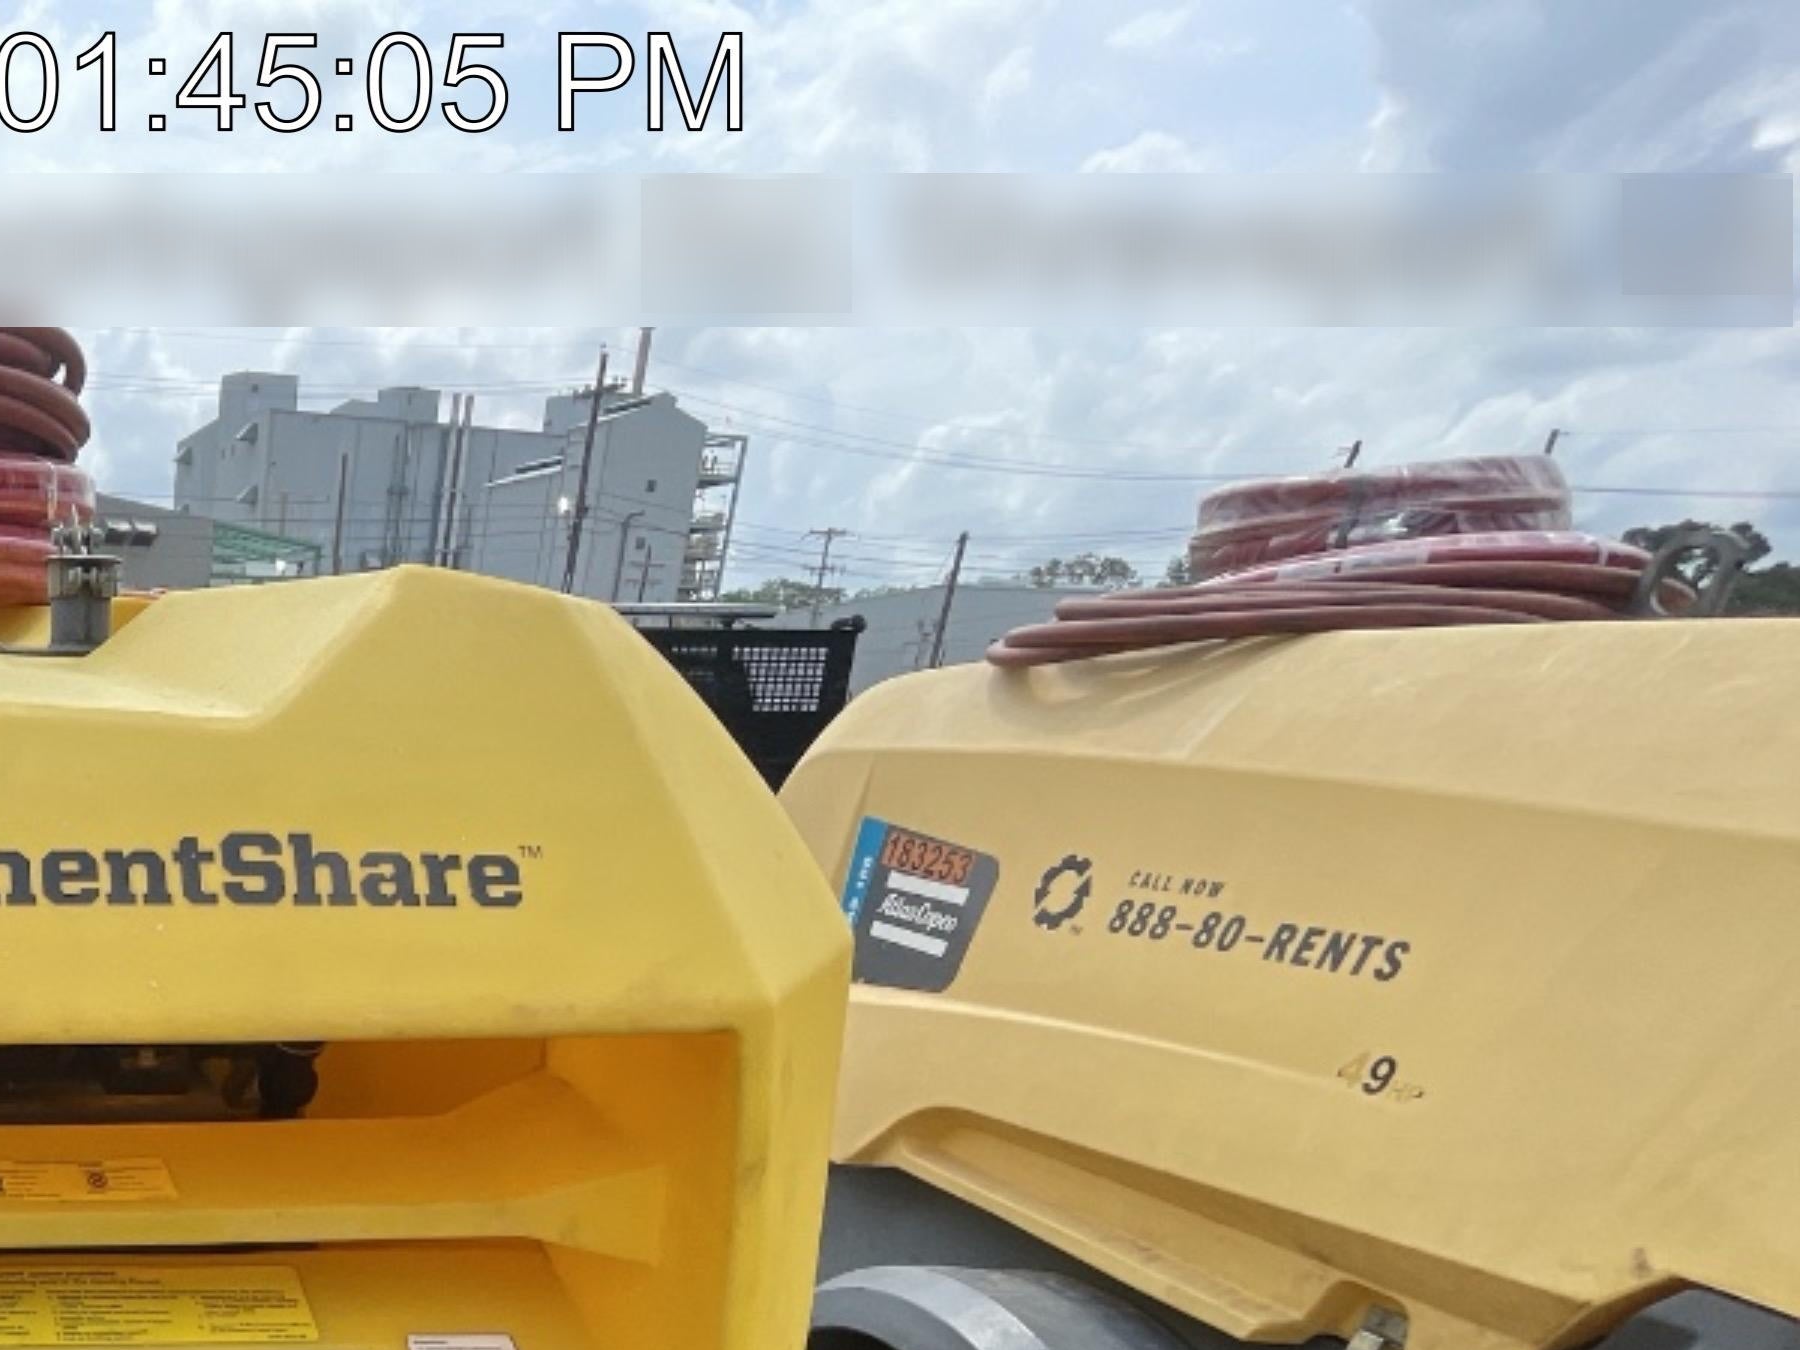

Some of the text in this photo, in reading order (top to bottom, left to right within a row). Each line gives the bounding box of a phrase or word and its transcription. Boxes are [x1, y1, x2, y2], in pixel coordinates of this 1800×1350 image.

[886, 832, 973, 885] 183253
[1129, 870, 1225, 898] CALL NOW
[1107, 899, 1411, 982] 888-80-RENTS
